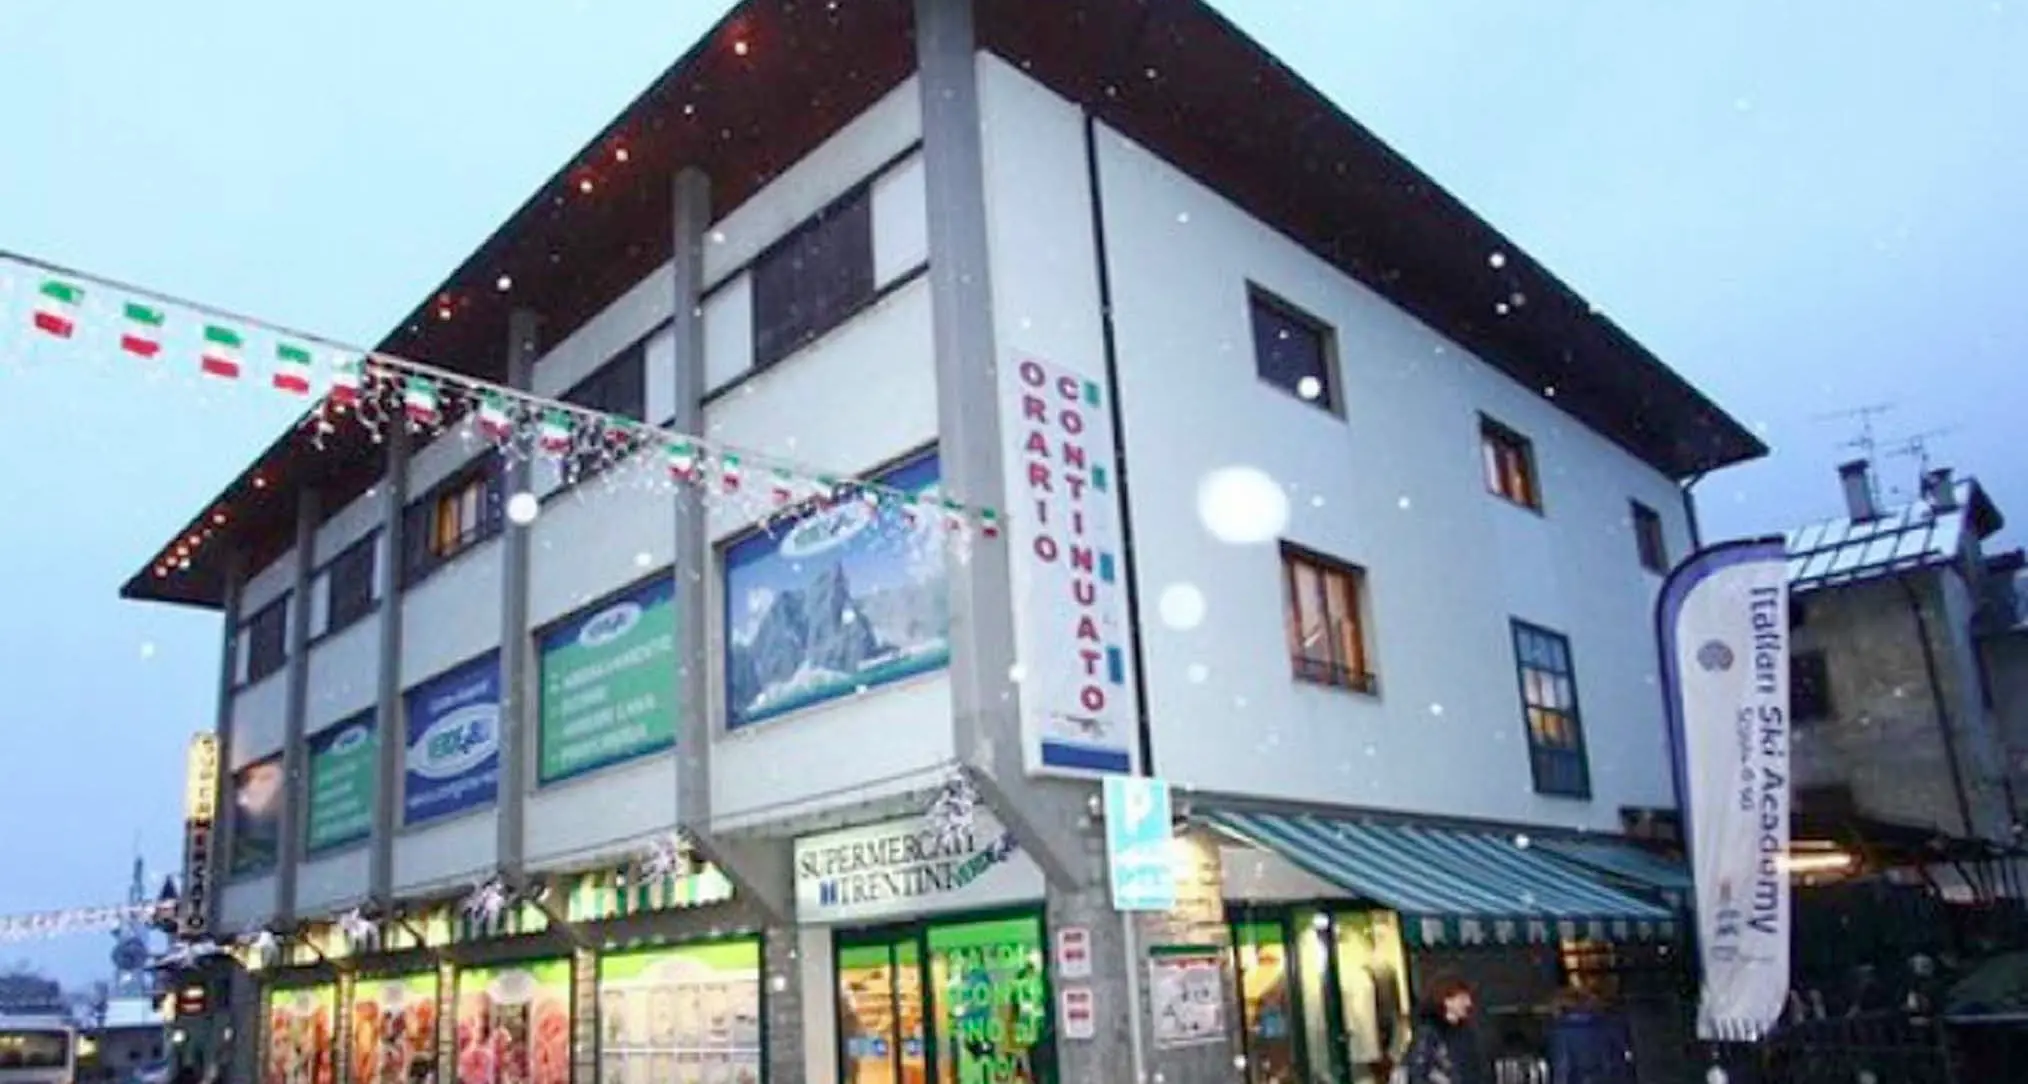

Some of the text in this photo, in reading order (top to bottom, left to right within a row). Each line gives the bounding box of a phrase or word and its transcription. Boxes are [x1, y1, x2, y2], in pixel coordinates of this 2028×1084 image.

[1019, 361, 1058, 563] ORARIO
[1057, 376, 1106, 711] CONTINUATO
[1758, 706, 1785, 757] Ski
